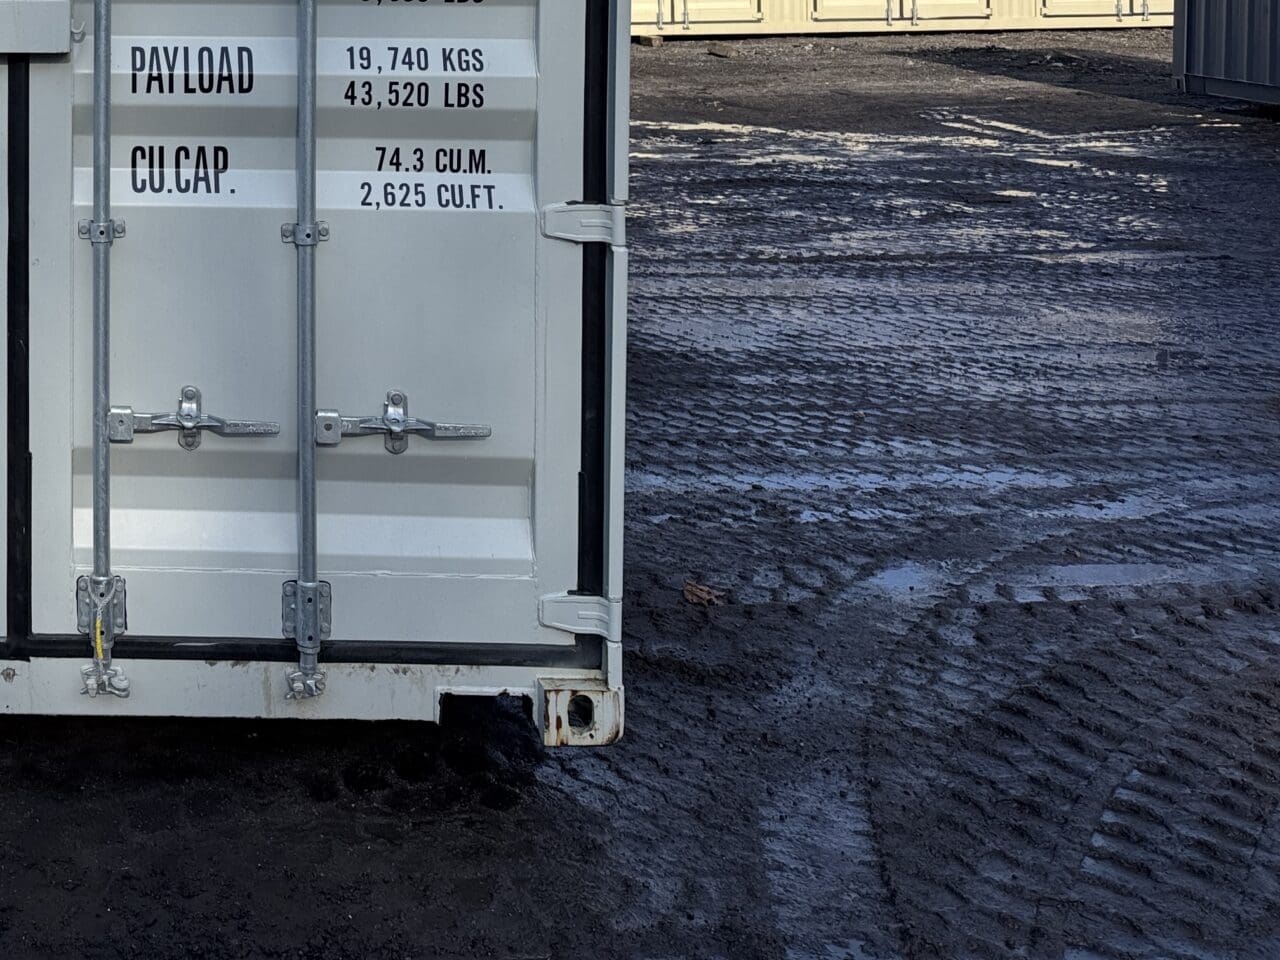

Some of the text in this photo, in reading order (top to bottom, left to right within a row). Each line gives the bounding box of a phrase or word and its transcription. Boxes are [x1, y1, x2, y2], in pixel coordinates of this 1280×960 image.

[131, 46, 484, 94] PAYLOAD 19,740 KGS
[344, 81, 484, 110] 43,520 LBS
[131, 146, 492, 194] CU.CAP. 74.3 CU.M.
[360, 182, 504, 210] 2,625 CU.FT.
